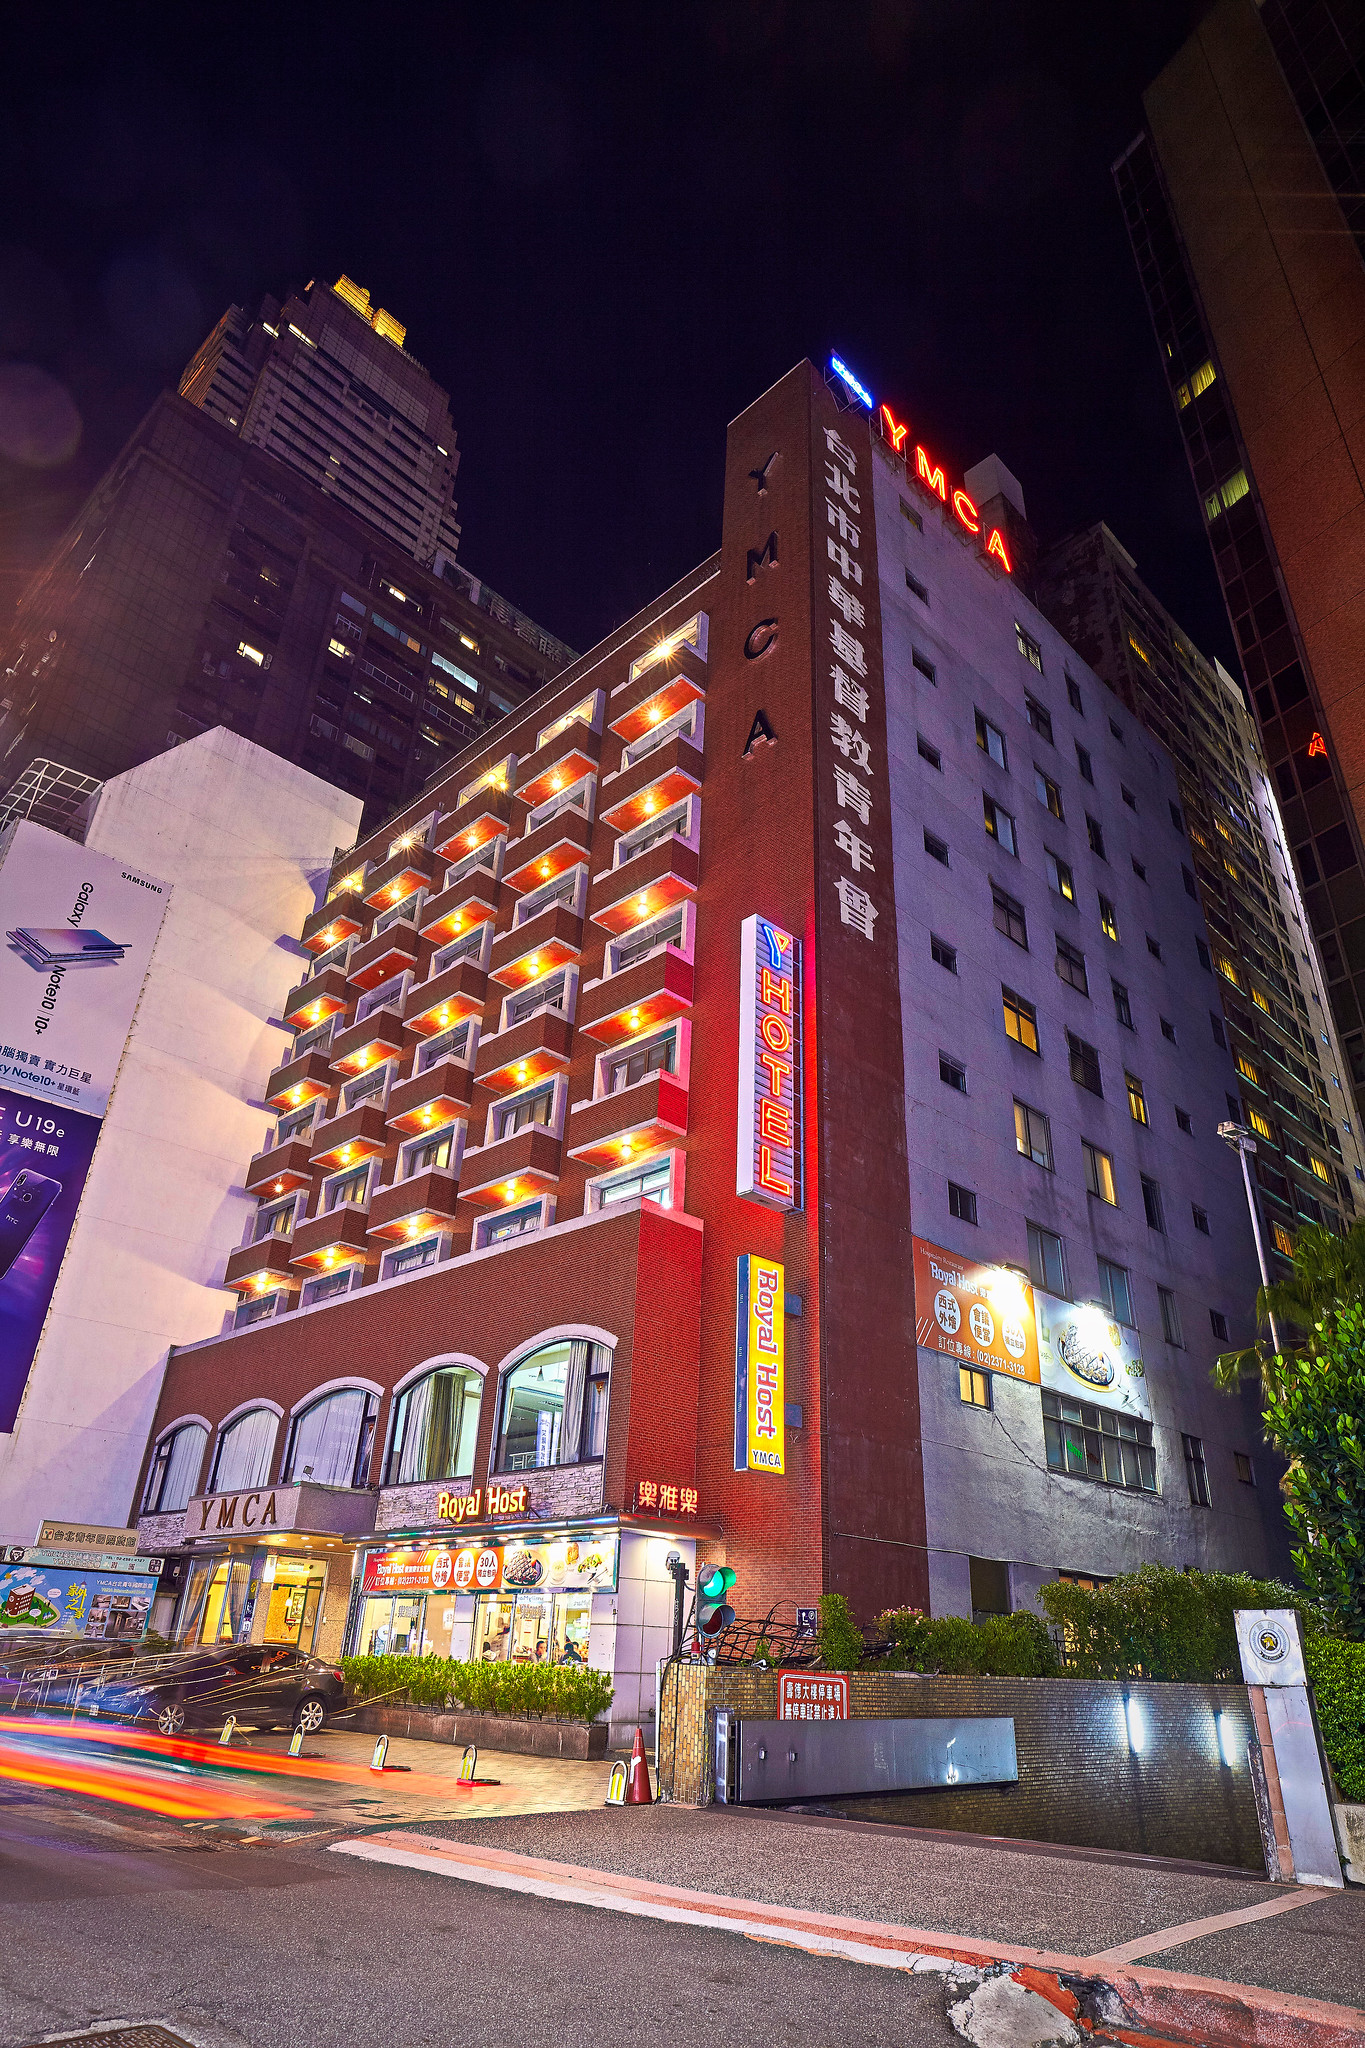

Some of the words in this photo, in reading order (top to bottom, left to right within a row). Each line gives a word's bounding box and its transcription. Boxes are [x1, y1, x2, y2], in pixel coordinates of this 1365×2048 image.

[881, 404, 1011, 573] YMCA
[742, 451, 780, 760] YMCA
[822, 425, 880, 942] 台北市中華基督教青年會
[121, 871, 163, 894] SAMSUNG
[66, 882, 94, 928] Galaxy
[12, 1066, 56, 1086] Note10+
[43, 1059, 92, 1085] 實力巨星
[760, 967, 791, 1197] HOTEL
[15, 1110, 66, 1138] U19e
[7, 1133, 60, 1157] 享樂無限
[929, 1261, 957, 1287] Royal
[957, 1272, 979, 1296] Host
[754, 1268, 779, 1356] Royal
[937, 1293, 957, 1313] 西式
[976, 1349, 1026, 1376] (02)2371-3128
[755, 1362, 779, 1439] Host
[752, 1450, 782, 1468] YMCA
[199, 1491, 277, 1531] YMCA
[438, 1488, 481, 1523] Royal
[487, 1486, 527, 1515] Host
[638, 1480, 698, 1514] 樂雅樂
